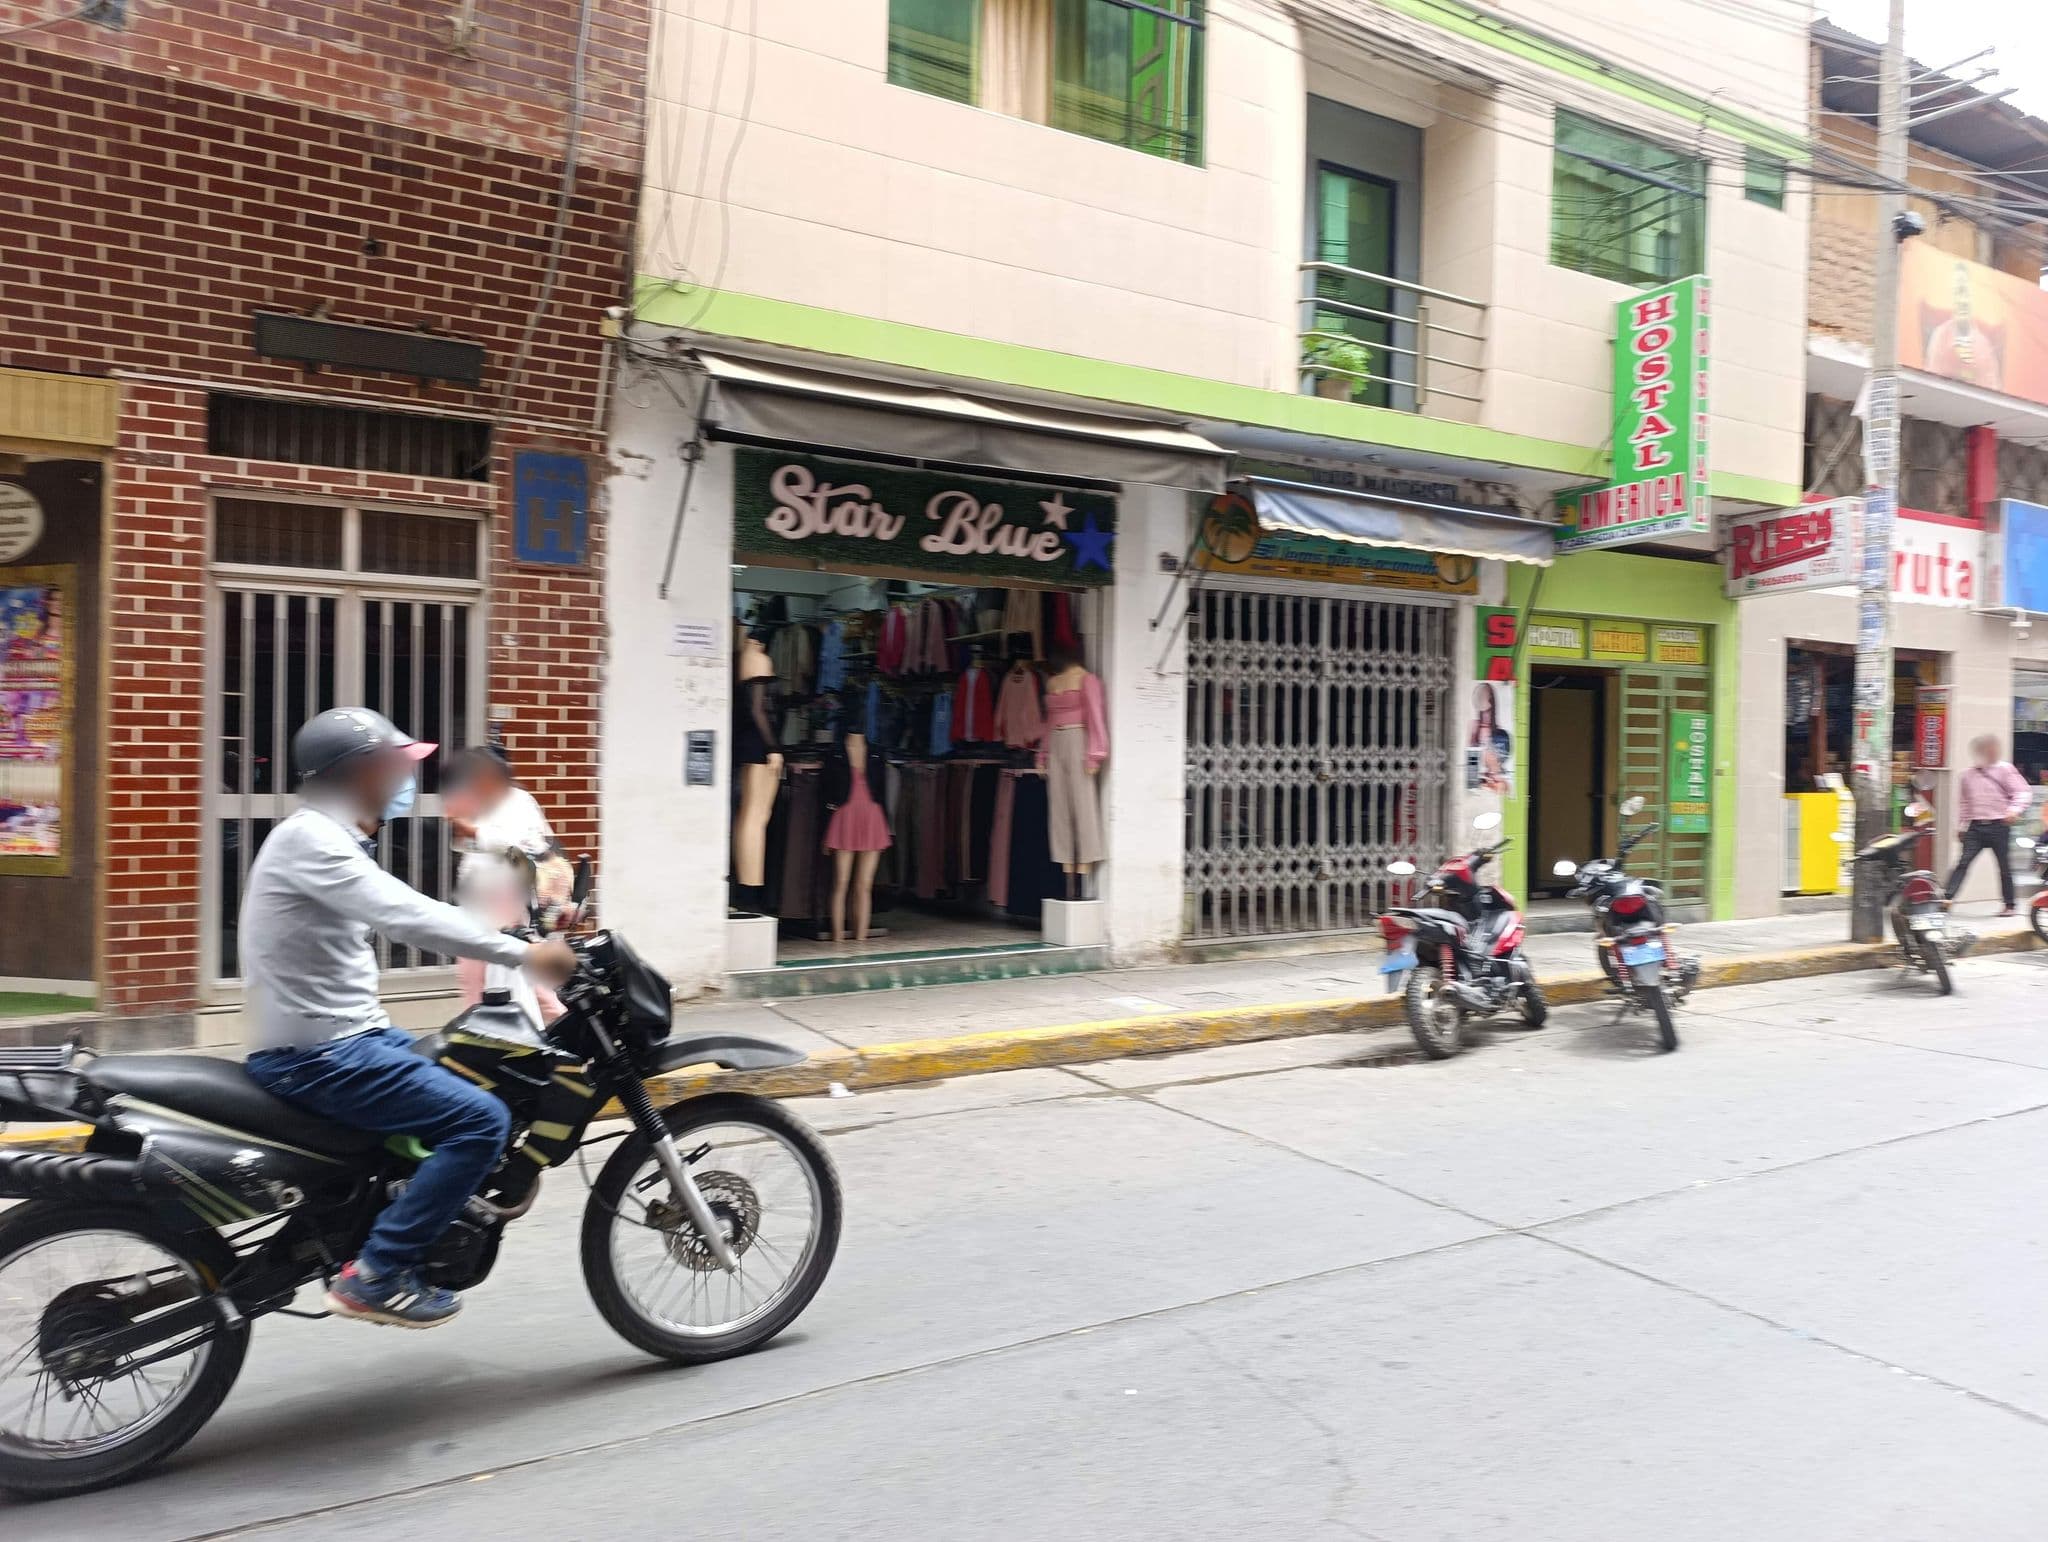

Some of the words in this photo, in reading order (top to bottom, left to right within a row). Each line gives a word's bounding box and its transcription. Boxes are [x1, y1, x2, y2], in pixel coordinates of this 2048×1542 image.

[1631, 293, 1677, 468] HOSTAL
[528, 496, 575, 552] H
[765, 465, 905, 540] Star
[920, 491, 1065, 561] Blue
[1578, 472, 1687, 531] AMERICA
